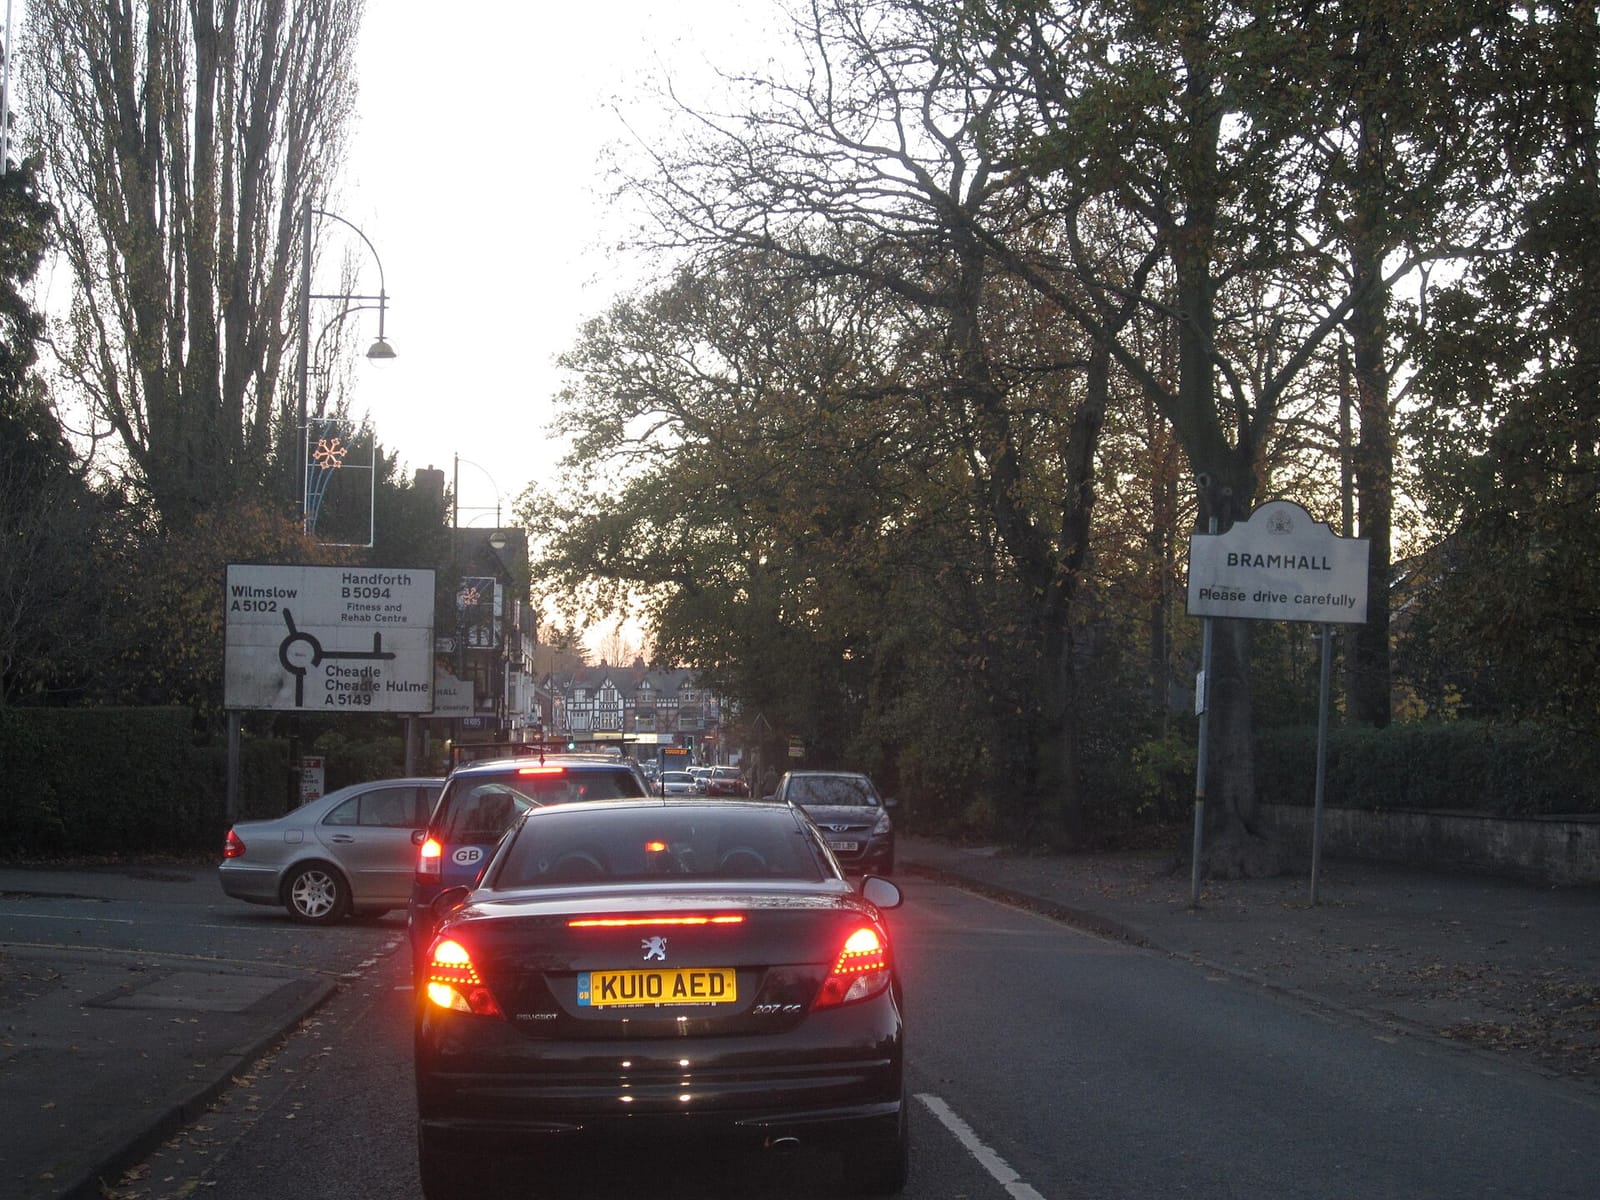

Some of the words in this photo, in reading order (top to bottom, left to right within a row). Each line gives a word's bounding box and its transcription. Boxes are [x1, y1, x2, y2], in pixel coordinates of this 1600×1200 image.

[1227, 552, 1332, 570] BRAMHALL
[342, 572, 412, 587] Handforth
[231, 585, 298, 600] Wilmslow
[1199, 588, 1246, 602] Please
[1253, 590, 1288, 604] drive
[1294, 594, 1357, 609] carefully
[346, 602, 381, 612] Fitness
[384, 603, 402, 613] and
[340, 613, 371, 623] Rehab
[374, 614, 408, 624] Centre
[325, 664, 382, 678] Cheadle
[324, 679, 381, 693] Cheadle
[385, 680, 429, 693] Hulme
[456, 850, 479, 861] GB
[602, 974, 662, 1000] KU10
[673, 972, 725, 997] AED
[752, 1004, 782, 1015] 207
